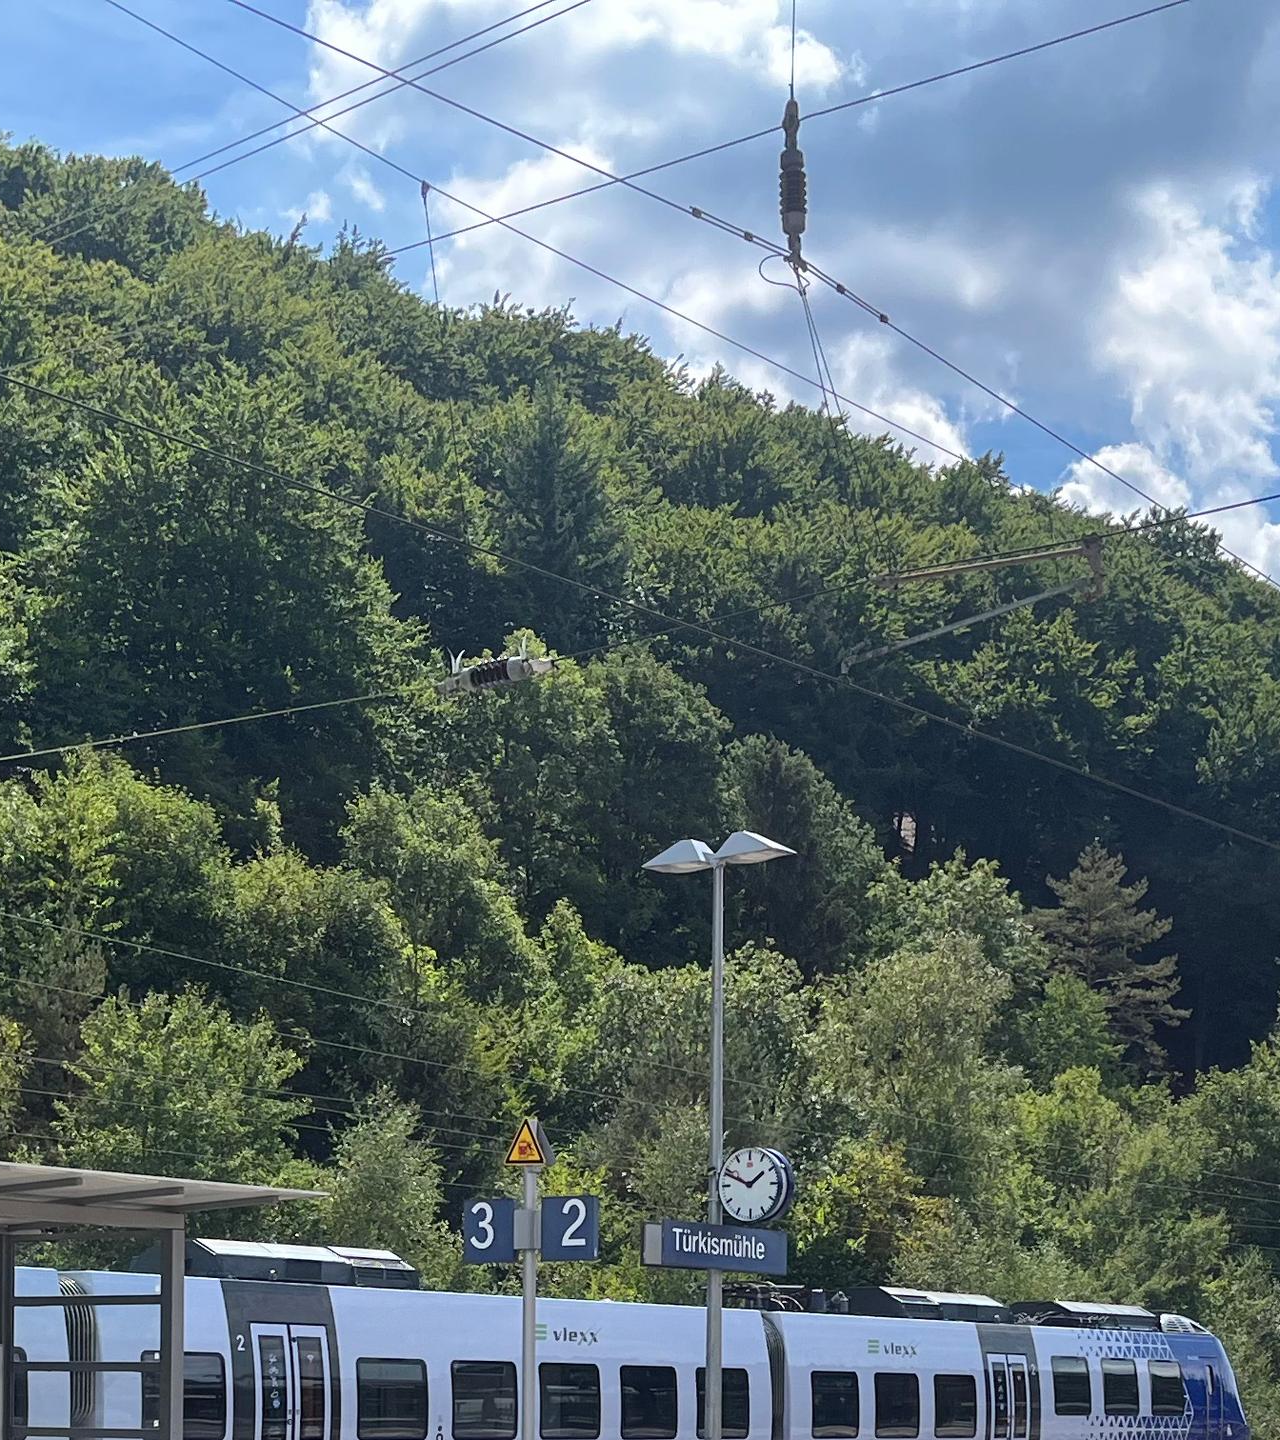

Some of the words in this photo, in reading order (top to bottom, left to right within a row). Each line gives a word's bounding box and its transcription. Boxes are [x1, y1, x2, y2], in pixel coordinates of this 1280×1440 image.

[470, 1201, 495, 1250] 3
[561, 1198, 587, 1247] 2
[672, 1227, 766, 1260] Türkismühle
[236, 1334, 246, 1351] 2
[553, 1327, 601, 1346] vlexx
